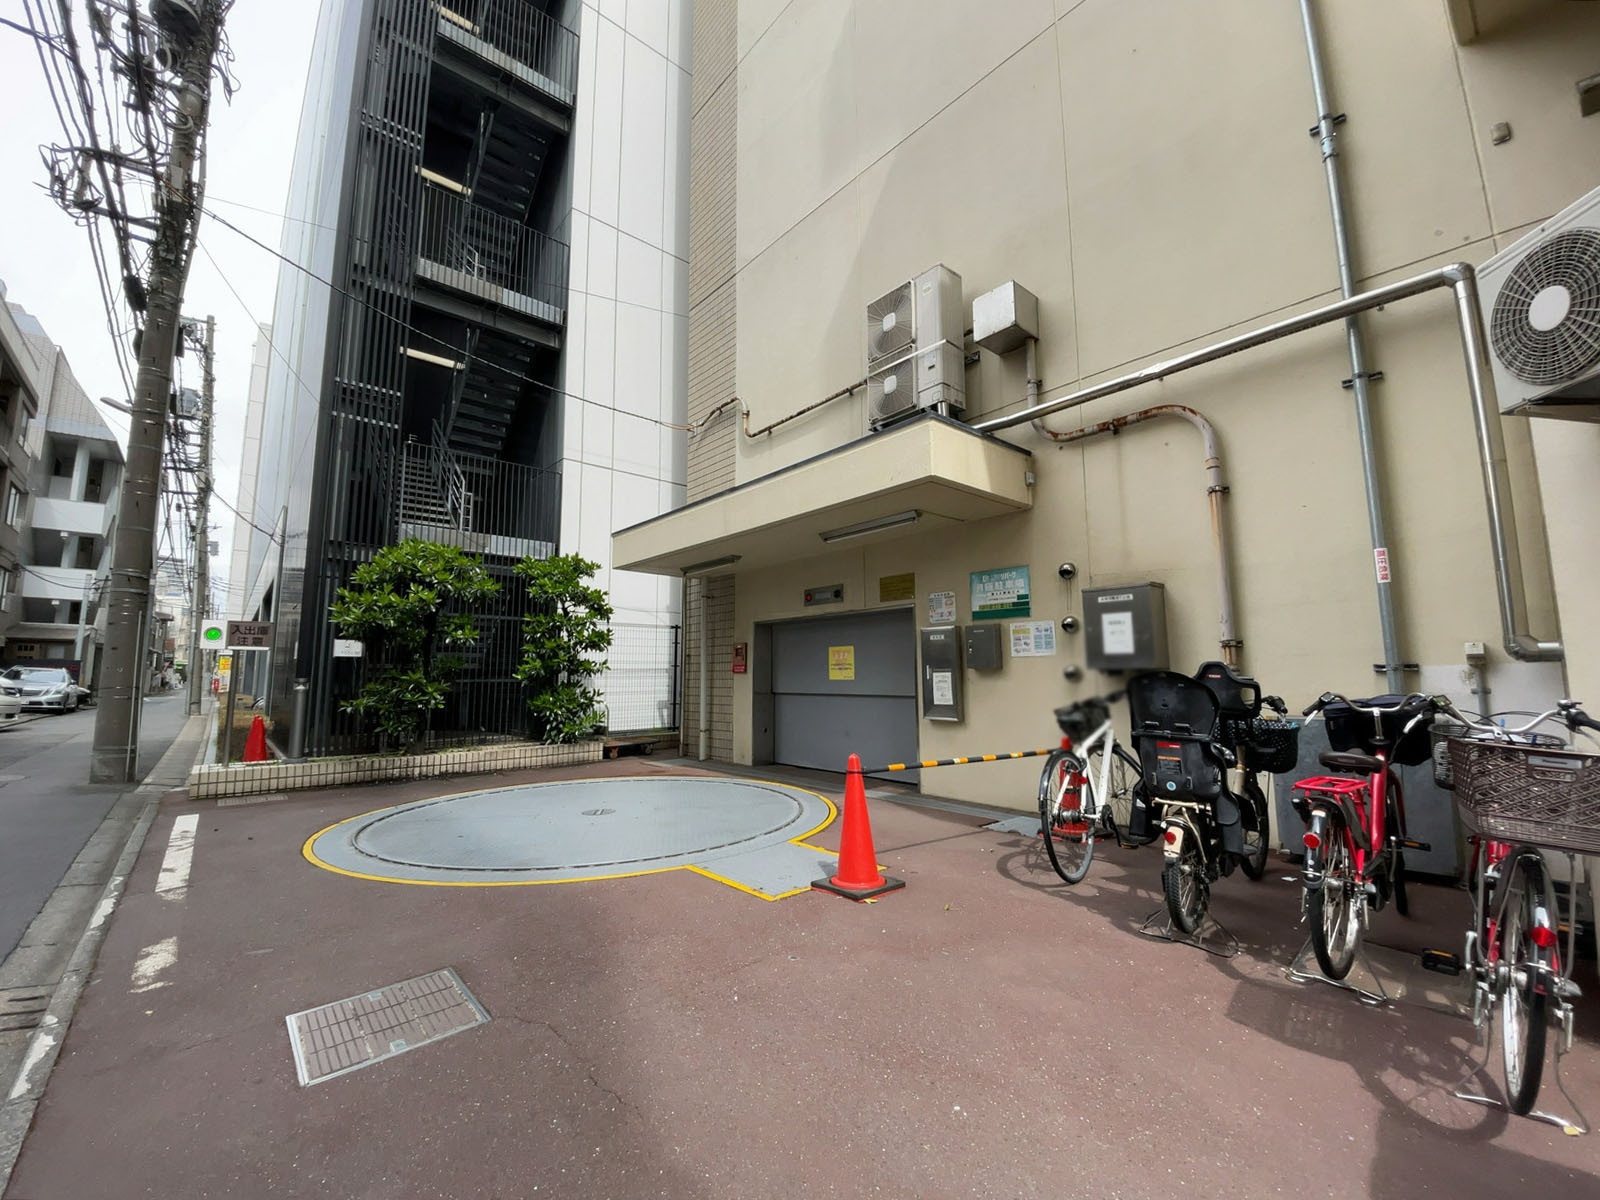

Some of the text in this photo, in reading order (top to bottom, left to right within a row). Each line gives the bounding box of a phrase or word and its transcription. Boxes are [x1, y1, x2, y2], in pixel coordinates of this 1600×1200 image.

[232, 625, 269, 635] 入出庫
[237, 637, 264, 646] 注意
